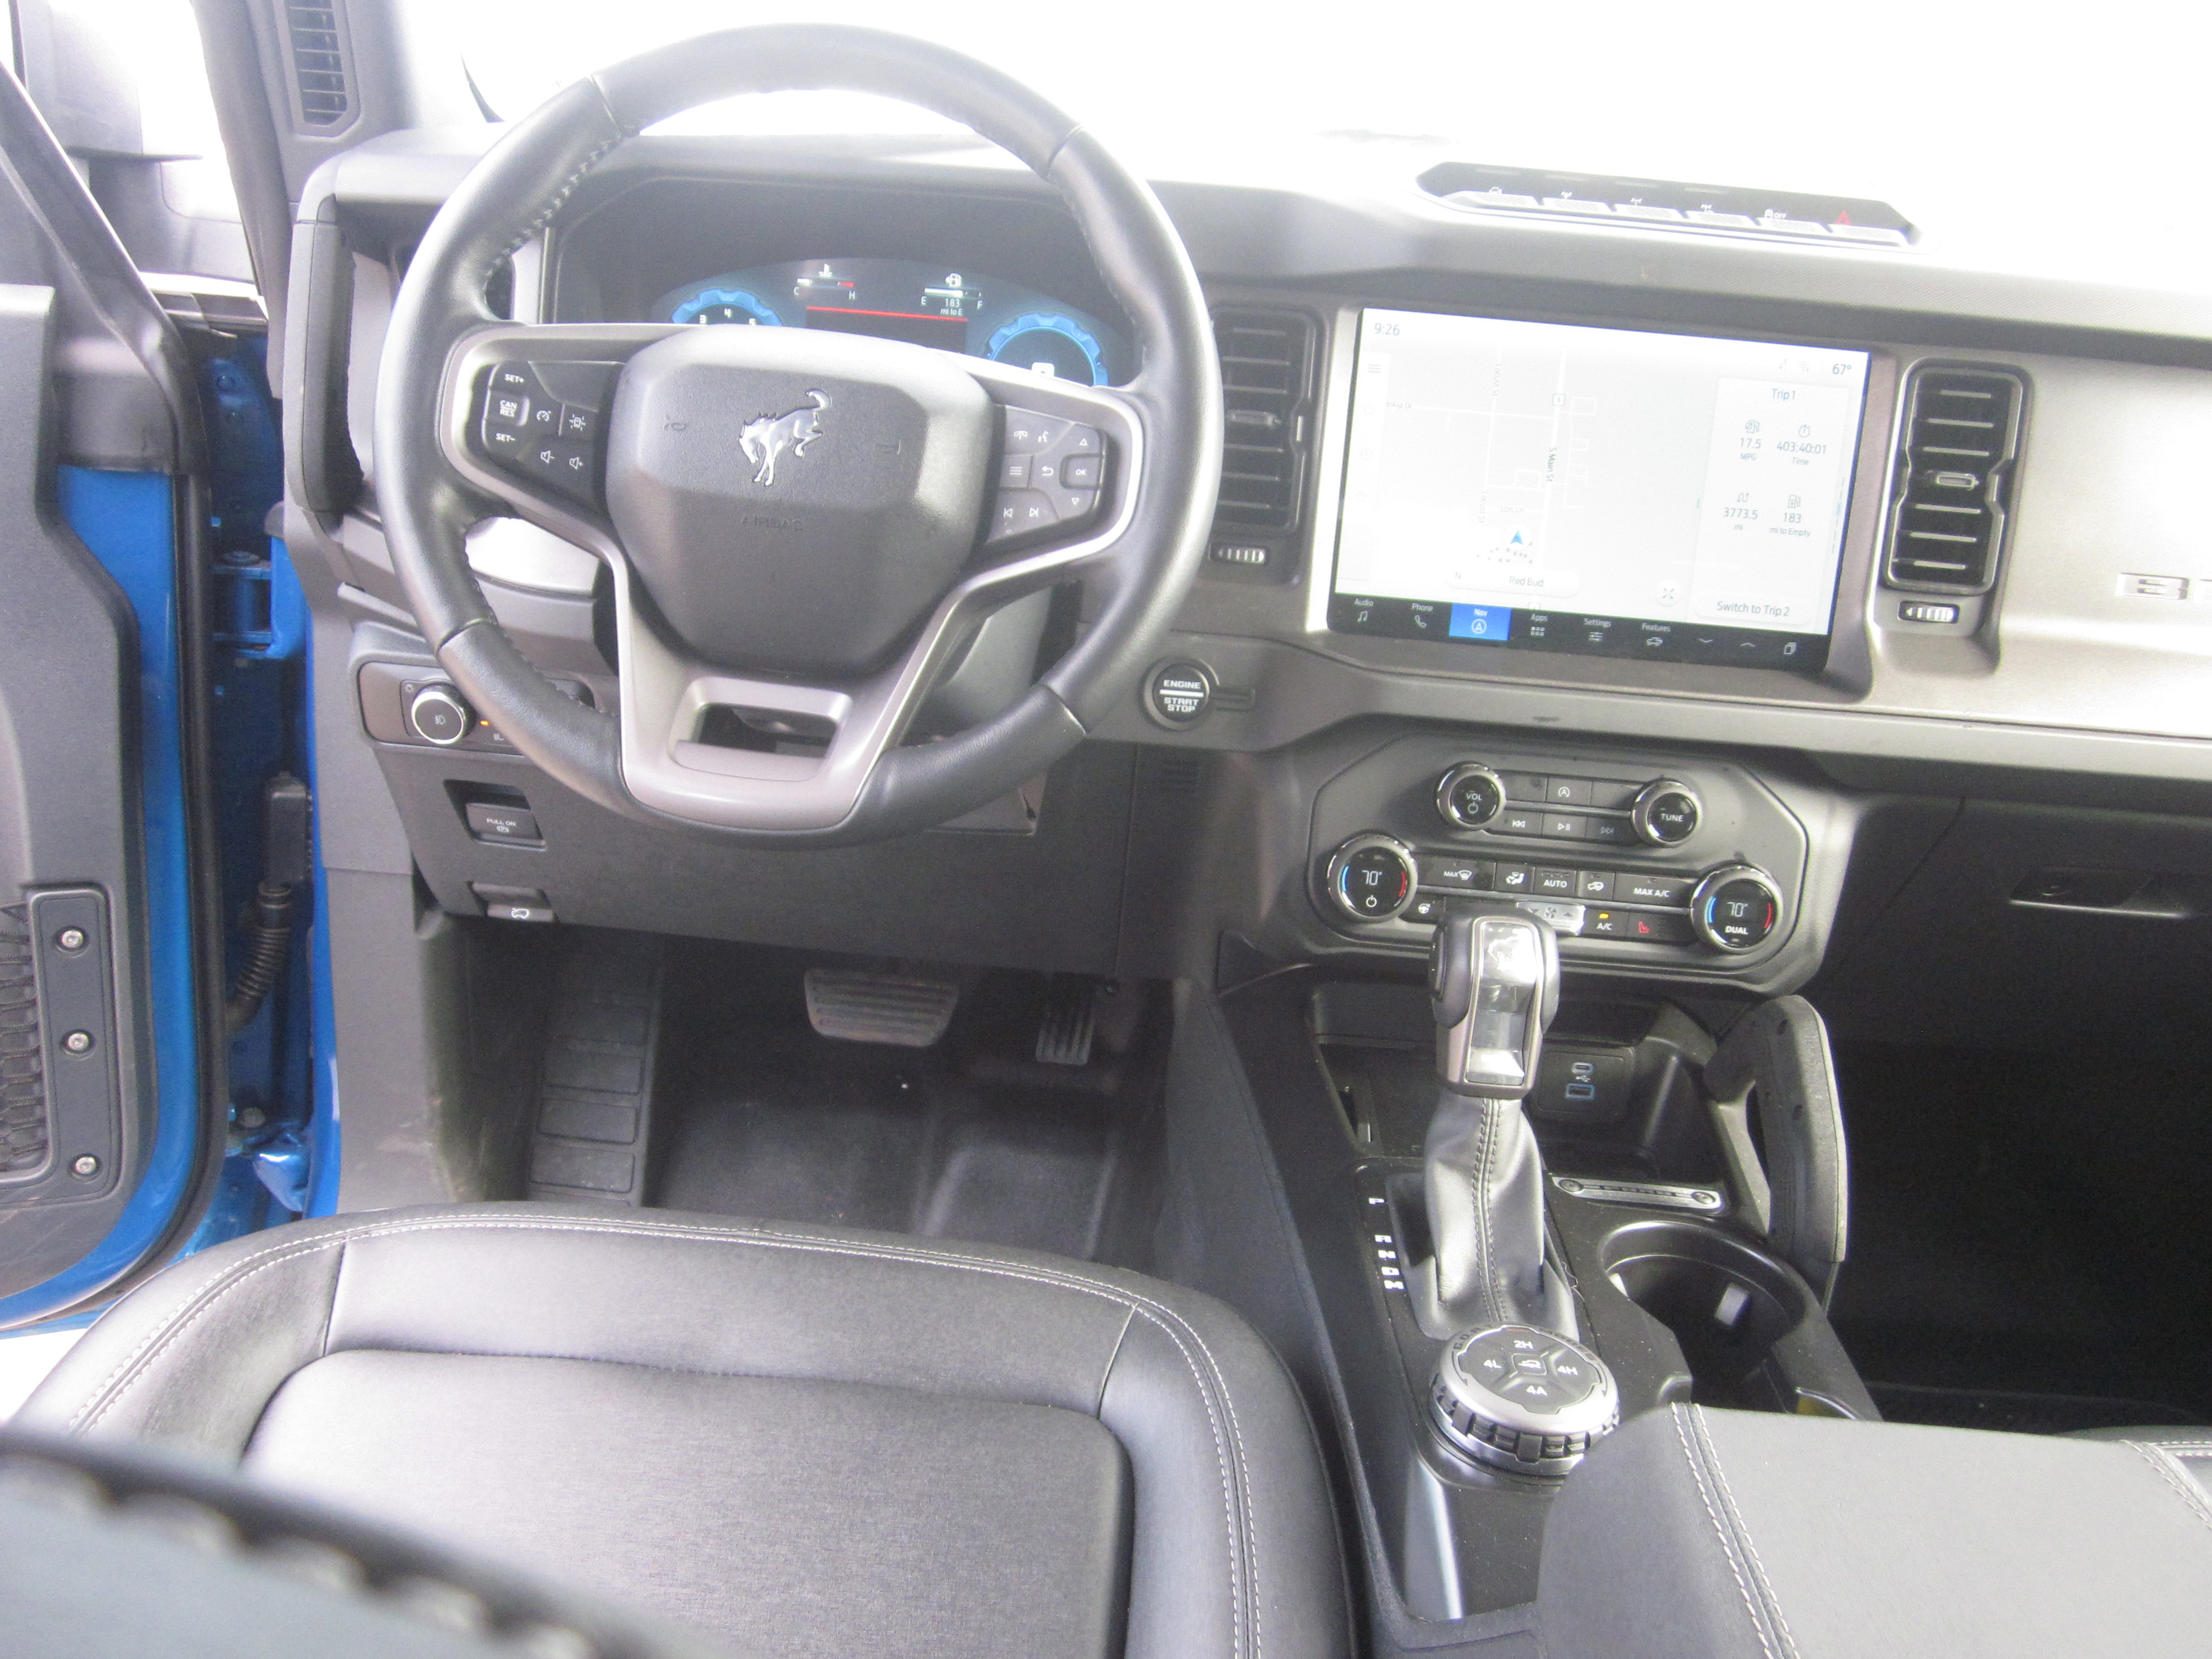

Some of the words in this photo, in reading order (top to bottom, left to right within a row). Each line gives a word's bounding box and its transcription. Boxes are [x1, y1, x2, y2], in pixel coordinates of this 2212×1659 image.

[794, 286, 800, 295] C
[848, 290, 855, 300] H
[921, 296, 927, 305] E
[945, 298, 960, 307] 183
[977, 300, 983, 310] F
[724, 308, 732, 318] 4
[699, 315, 707, 325] 3
[1374, 322, 1400, 336] 9:26
[1832, 363, 1852, 375] 67°
[1771, 388, 1790, 401] Trip
[1792, 390, 1796, 400] 1
[499, 400, 518, 409] CAN
[499, 408, 515, 418] RES
[1740, 437, 1761, 449] 17.5
[1776, 441, 1827, 455] 403:40:01
[1547, 453, 1556, 472] Main
[1792, 457, 1809, 465] Time
[1546, 474, 1554, 482] St
[1723, 507, 1759, 520] 3773.5
[1783, 513, 1802, 524] 183
[1788, 528, 1811, 538] Empty
[1455, 571, 1462, 580] N
[1509, 576, 1525, 586] Red
[1527, 577, 1545, 587] Bud
[1354, 598, 1374, 607] Audio
[1411, 603, 1433, 612] Phone
[1474, 608, 1488, 617] Nav
[1717, 601, 1749, 613] Switch
[1751, 603, 1761, 614] to
[1763, 604, 1782, 618] Trip
[1783, 606, 1790, 617] 2
[1531, 613, 1548, 623] Apps
[1584, 618, 1612, 628] Settings
[1642, 623, 1671, 632] Features
[1163, 680, 1201, 689] ENGINE
[1164, 697, 1199, 706] START
[1167, 704, 1196, 712] STOP
[1466, 792, 1482, 801] VOL
[1661, 813, 1684, 822] TUNE
[1444, 870, 1458, 878] MAX
[1543, 879, 1567, 888] AUTO
[1634, 887, 1651, 896] MAX
[1652, 889, 1671, 898] A/C
[1597, 922, 1613, 931] A/C
[1725, 926, 1749, 935] DUAL
[1378, 1249, 1396, 1259] N
[1381, 1266, 1400, 1276] D
[1384, 1280, 1405, 1289] M
[1513, 1340, 1533, 1349] 2H
[1483, 1359, 1503, 1369] 4L
[1557, 1365, 1578, 1376] 4H
[1526, 1385, 1548, 1396] 4A
